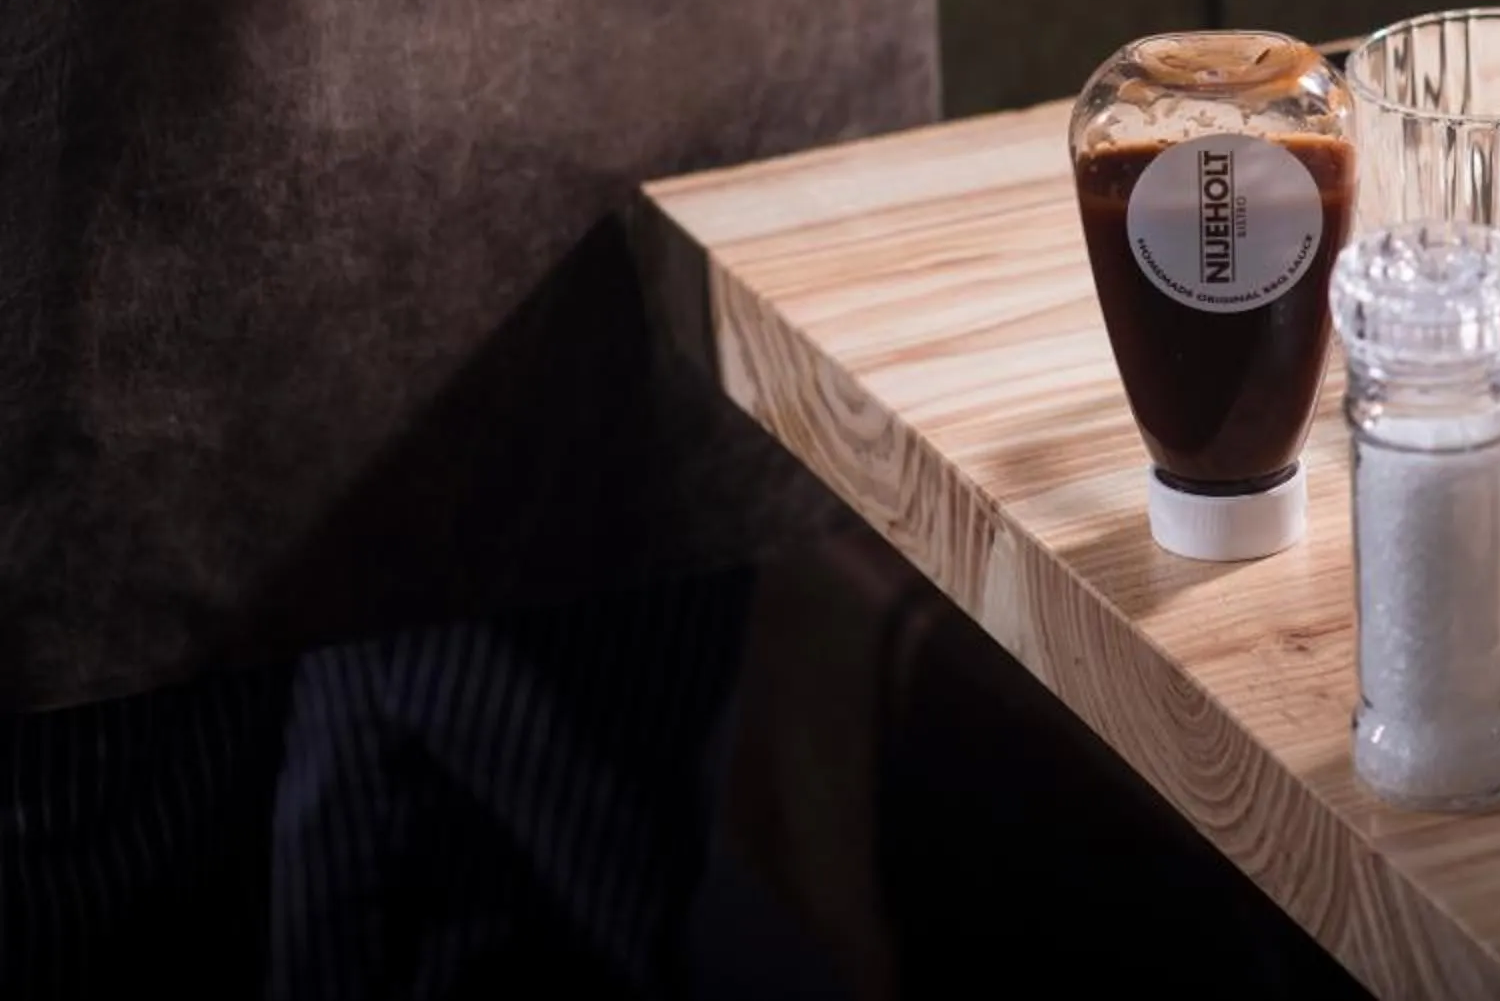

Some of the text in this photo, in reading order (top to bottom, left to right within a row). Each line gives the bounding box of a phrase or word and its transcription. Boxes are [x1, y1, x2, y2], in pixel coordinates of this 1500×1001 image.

[1204, 150, 1230, 284] NIJEHOLT
[1137, 238, 1193, 297] HOMEMADE
[1196, 290, 1261, 304] ORIGINAL
[1288, 233, 1312, 275] SAUCE
